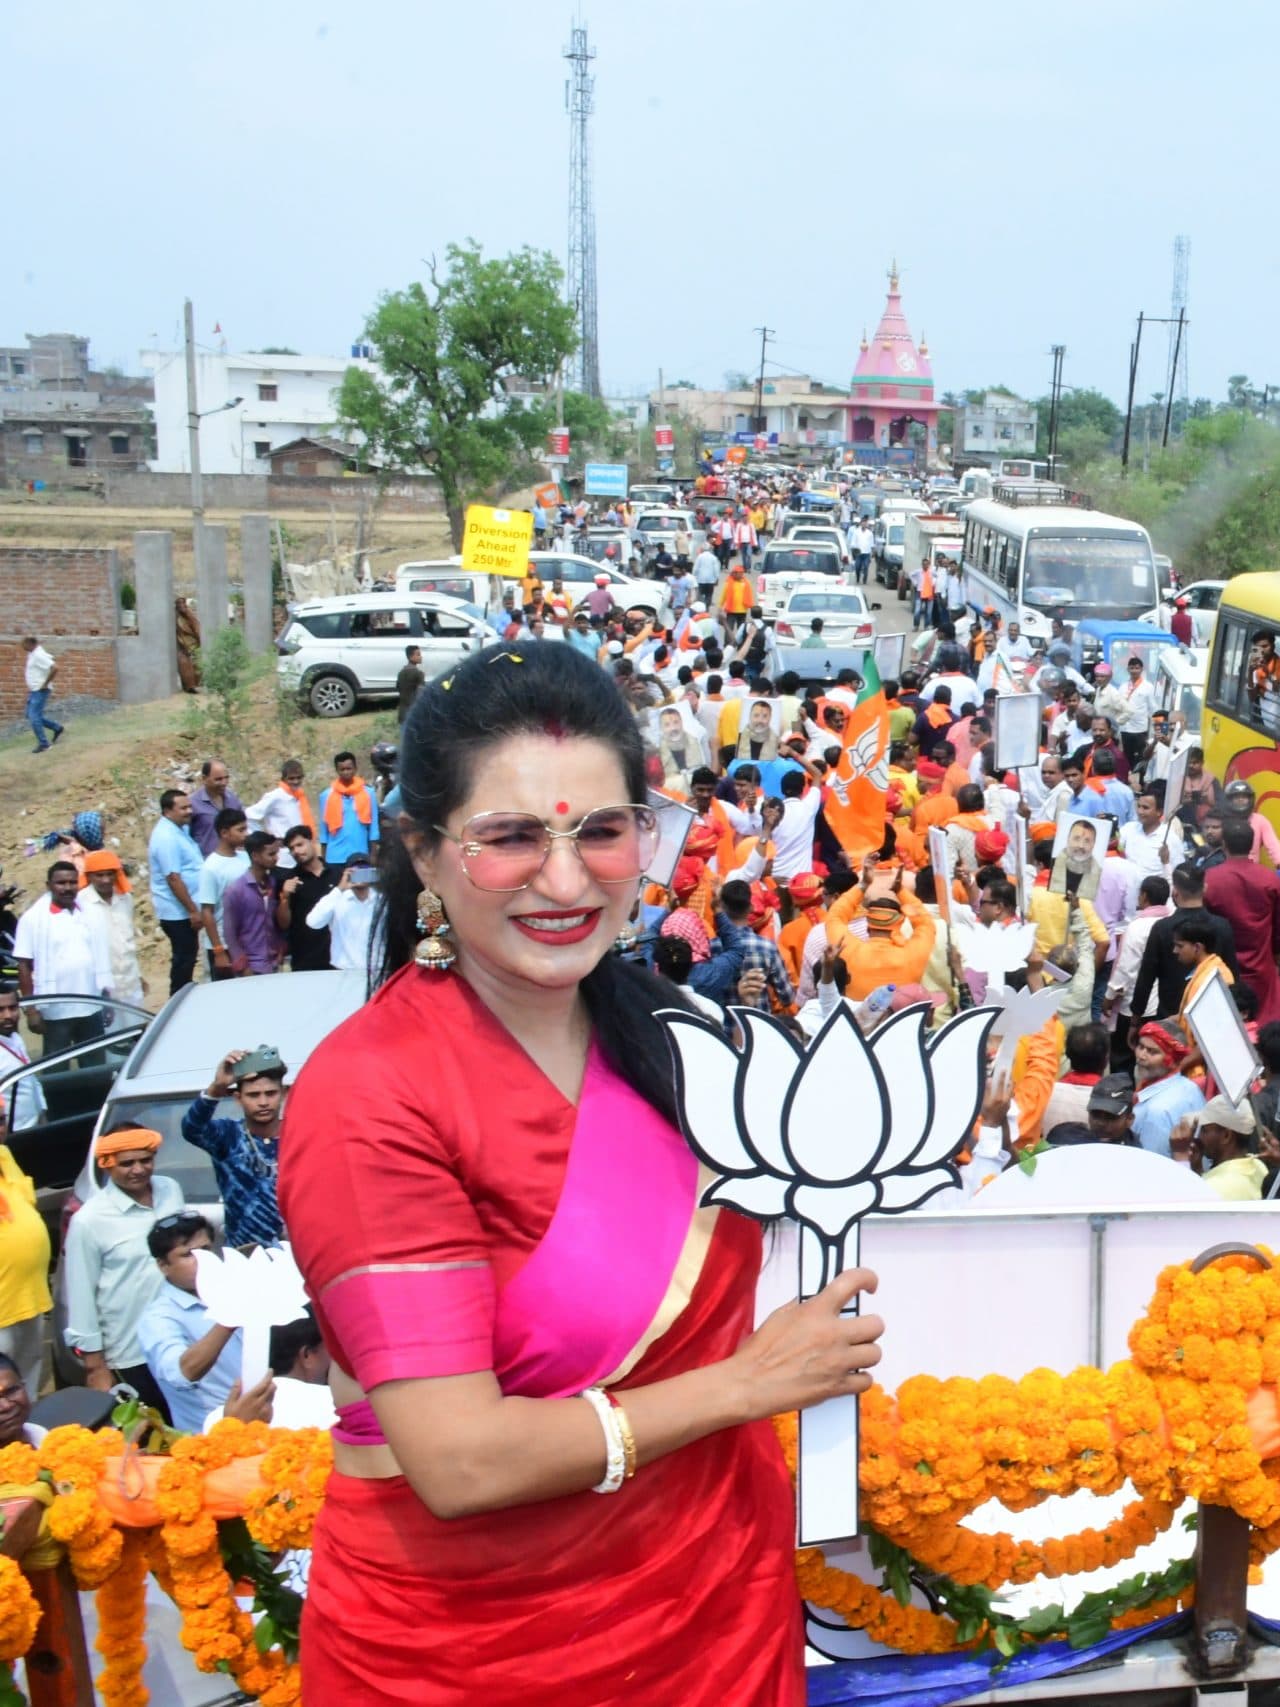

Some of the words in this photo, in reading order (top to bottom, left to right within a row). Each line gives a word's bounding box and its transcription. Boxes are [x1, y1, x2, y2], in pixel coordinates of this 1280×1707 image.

[469, 523, 528, 541] Diversion
[477, 539, 516, 553] Ahead
[472, 554, 494, 565] 250
